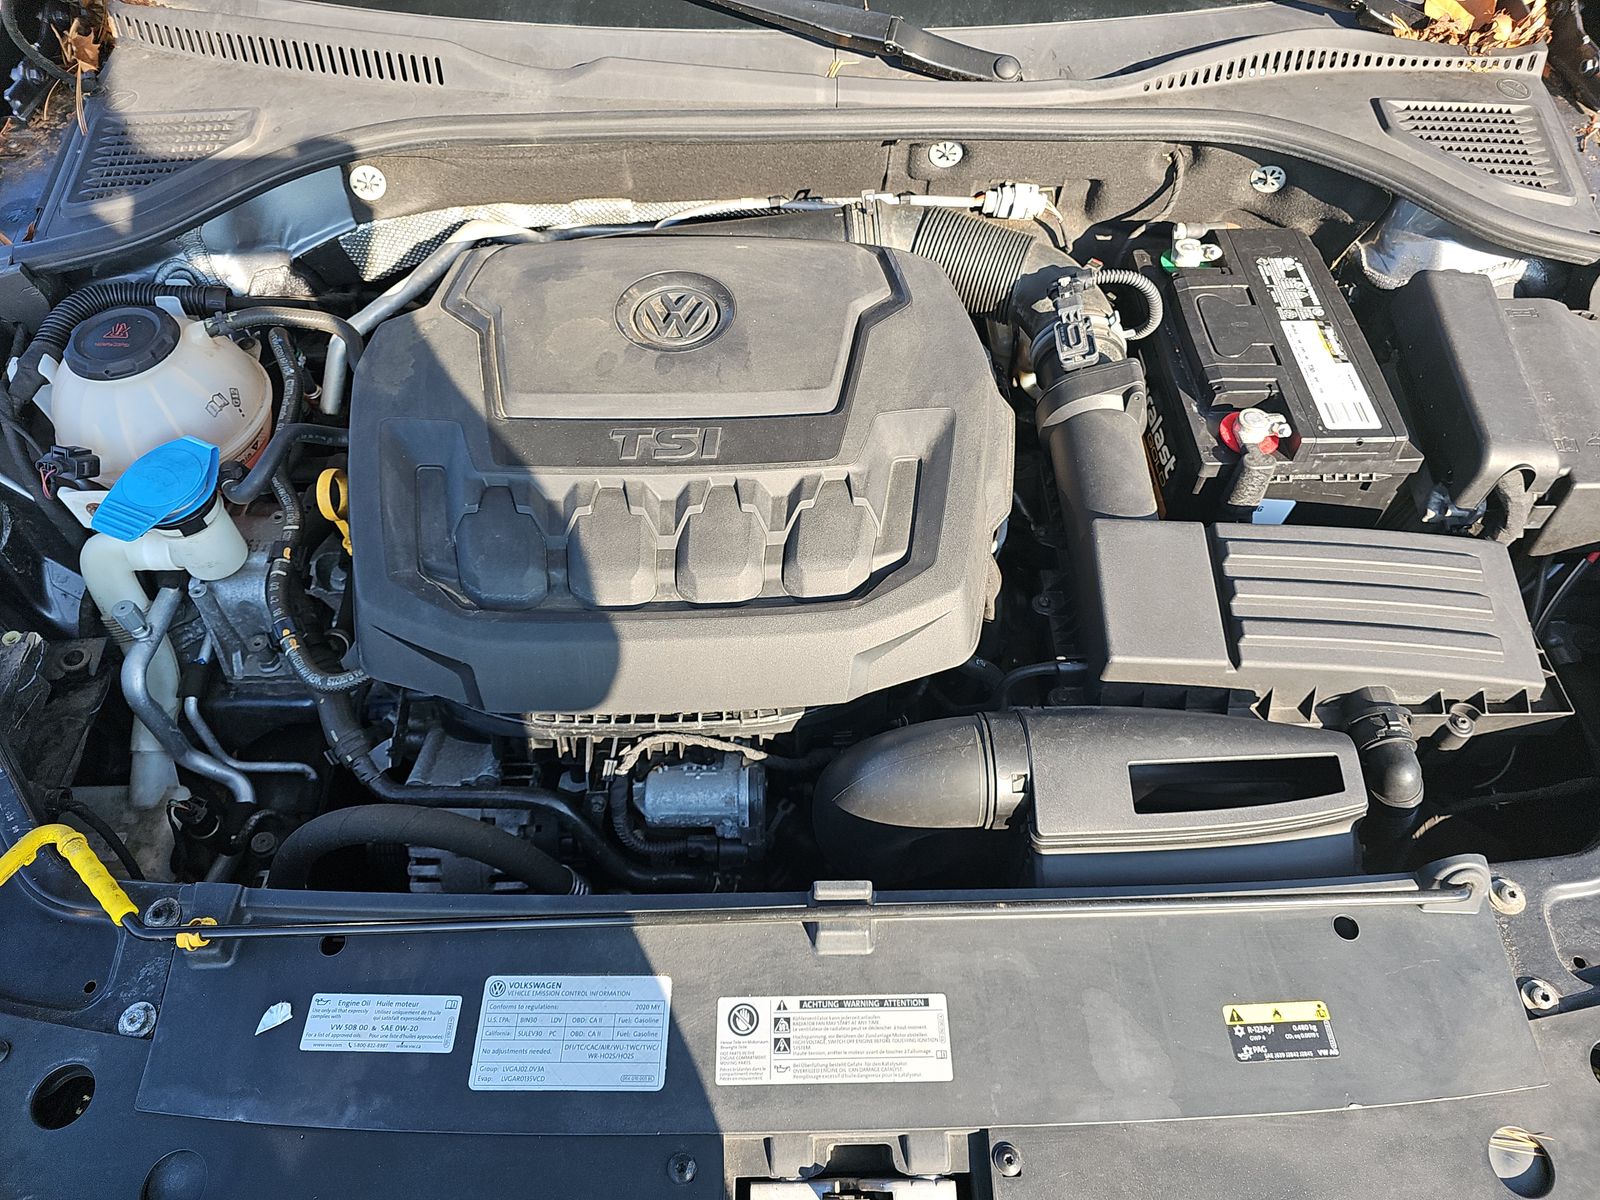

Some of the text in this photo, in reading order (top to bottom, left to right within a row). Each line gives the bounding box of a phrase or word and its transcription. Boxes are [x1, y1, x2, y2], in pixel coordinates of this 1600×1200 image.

[610, 426, 722, 461] TSI
[1145, 387, 1176, 480] ralast
[1247, 1024, 1274, 1034] R-1234yf
[1309, 1024, 1317, 1032] kg
